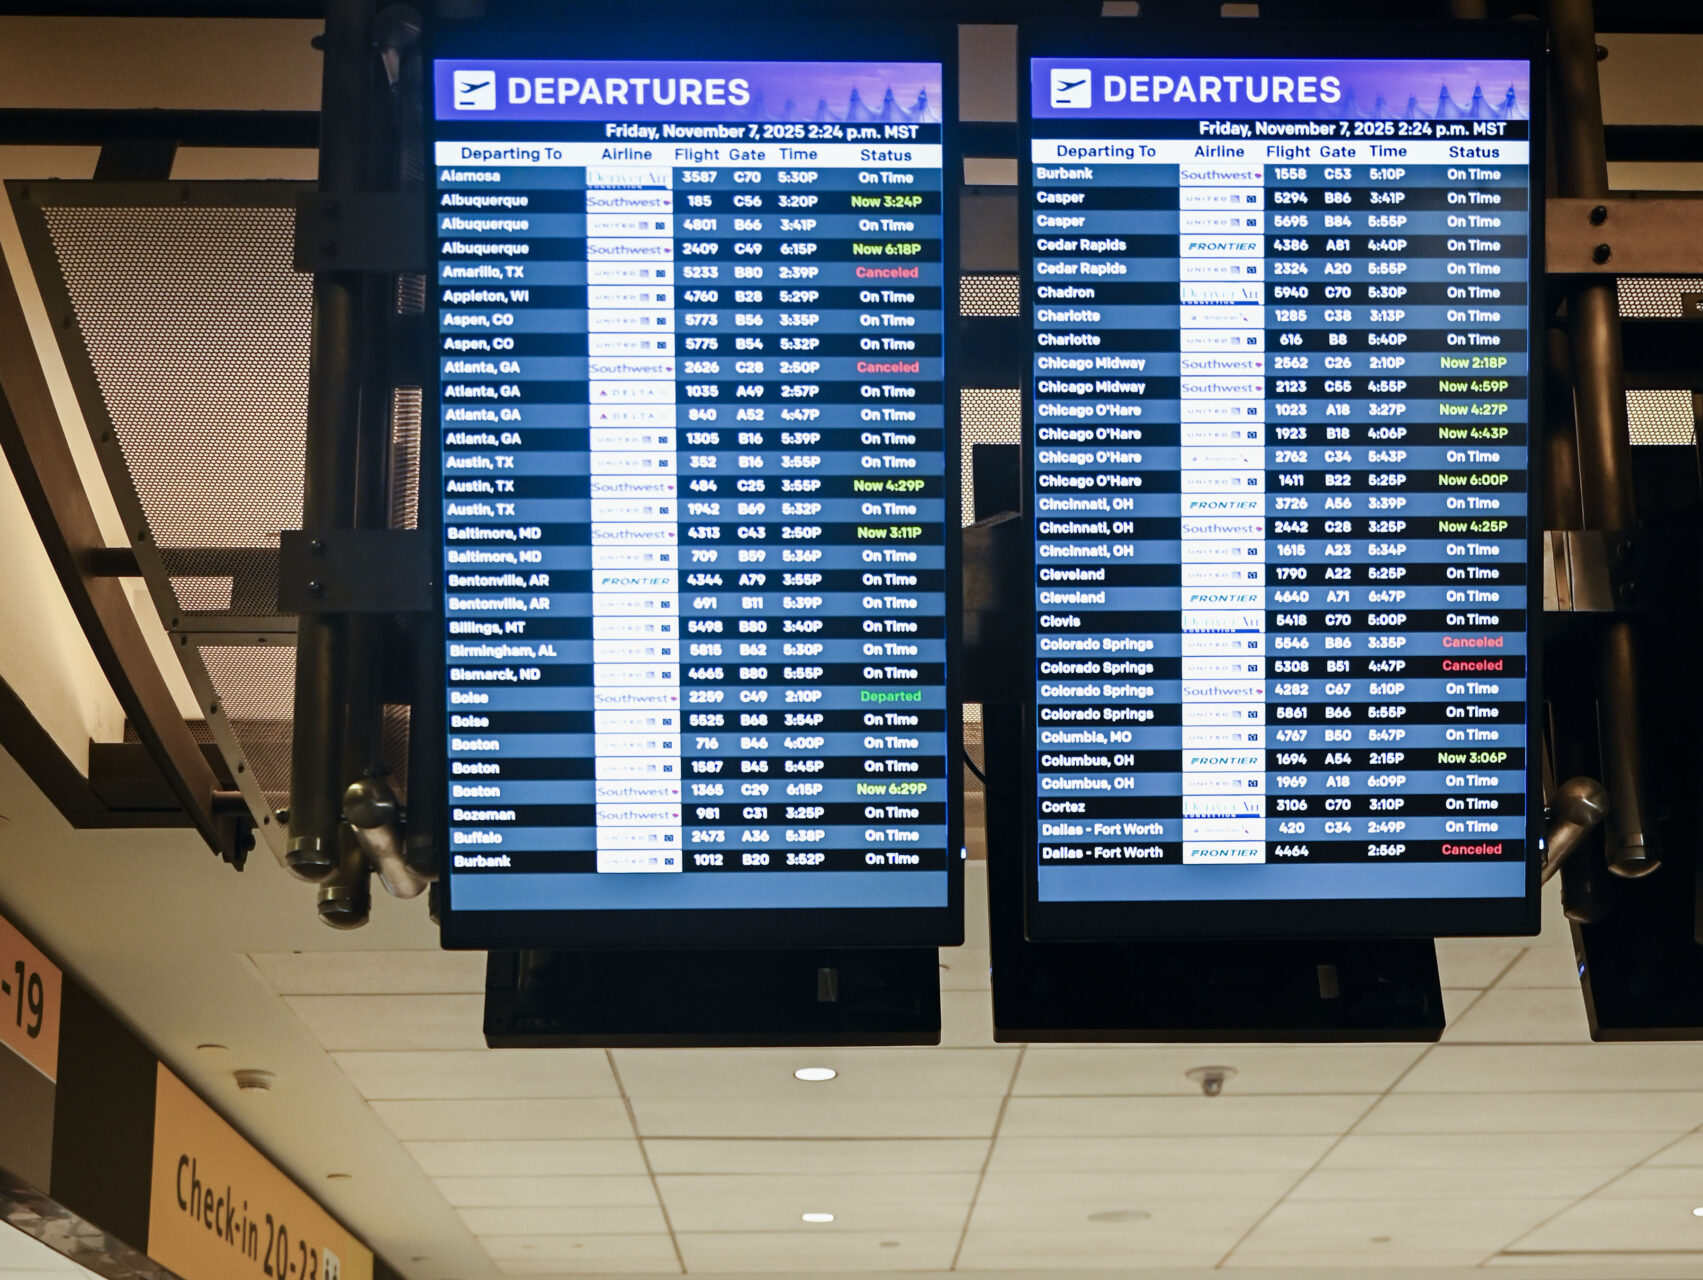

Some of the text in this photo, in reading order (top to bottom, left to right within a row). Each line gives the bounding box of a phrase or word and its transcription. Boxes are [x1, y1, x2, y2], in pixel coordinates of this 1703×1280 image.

[508, 77, 750, 106] DEPARTURES
[1104, 75, 1341, 103] DEPARTURES
[606, 123, 919, 141] Friday, November 7, 2025 2:24 p.m. MST
[1199, 120, 1507, 138] Friday, November 7, 2025 2:24 p.m. MST
[461, 146, 913, 164] Departing To Airline Flight Gate Time Status
[1056, 144, 1500, 160] Departing To Airline Flight Gate Time Status
[1036, 166, 1501, 181] Burbank Southwest 1558 C53 5:10P On Time
[441, 193, 923, 209] Albuquerque Southwest 185 C56 3:20P Now 3:24P
[1036, 191, 1085, 206] Casper
[1274, 191, 1308, 204] 5294
[1324, 191, 1352, 204] B86
[1370, 191, 1405, 204] 3:41P
[1447, 192, 1467, 204] On
[1468, 192, 1501, 204] Time
[1037, 238, 1501, 253] Cedar Rapids FRONTIER 4386 A81 4:40P On Time
[442, 265, 504, 280] Amarillo,
[504, 265, 524, 278] TX
[683, 265, 719, 279] 5233
[734, 266, 763, 279] B80
[778, 266, 819, 279] 2:39P
[855, 266, 919, 279] Canceled
[445, 384, 499, 399] Atlanta,
[500, 385, 521, 397] GA
[685, 385, 719, 398] 1035
[736, 385, 764, 398] A49
[781, 385, 820, 398] 2:57P
[860, 385, 881, 398] On
[881, 385, 916, 398] Time
[1038, 380, 1509, 395] Chicago Midway Southwest 2123 C55 4:55P Now 4:59P
[1038, 496, 1500, 512] Cincinnati, OH FRONTIER 3726 A56 3:39P On Time
[447, 526, 922, 541] Baltimore, MD Southwest 4313 C43 2:50P Now 3:11P
[448, 573, 918, 588] Bentonville, AR FRONTIER 4344 A79 3:55P On Time
[1040, 661, 1101, 674] Colorado
[1102, 661, 1154, 676] Springs
[1274, 660, 1309, 673] 5308
[1326, 660, 1350, 673] B51
[1368, 660, 1406, 672] 4:47P
[1442, 659, 1503, 671] Canceled
[450, 689, 922, 704] Boise Southwest 2259 C49 2:10P Departed
[1041, 752, 1507, 768] Columbus, OH FRONTIER 1694 A54 2:15P Now 3:06P
[453, 808, 516, 821] Bozeman
[598, 810, 670, 820] Southwest
[742, 807, 768, 820] C31
[785, 806, 825, 819] 3:25P
[864, 806, 885, 819] On
[885, 806, 920, 819] Time
[1042, 846, 1084, 859] Dallas
[1094, 846, 1122, 859] Fort
[1123, 845, 1164, 858] Worth
[1190, 848, 1259, 857] FRONTIER
[1274, 845, 1310, 857] 4464
[1367, 844, 1406, 856] 2:56P
[1441, 843, 1502, 855] Canceled
[2, 961, 44, 1039] -19
[176, 1154, 258, 1261] Check-in
